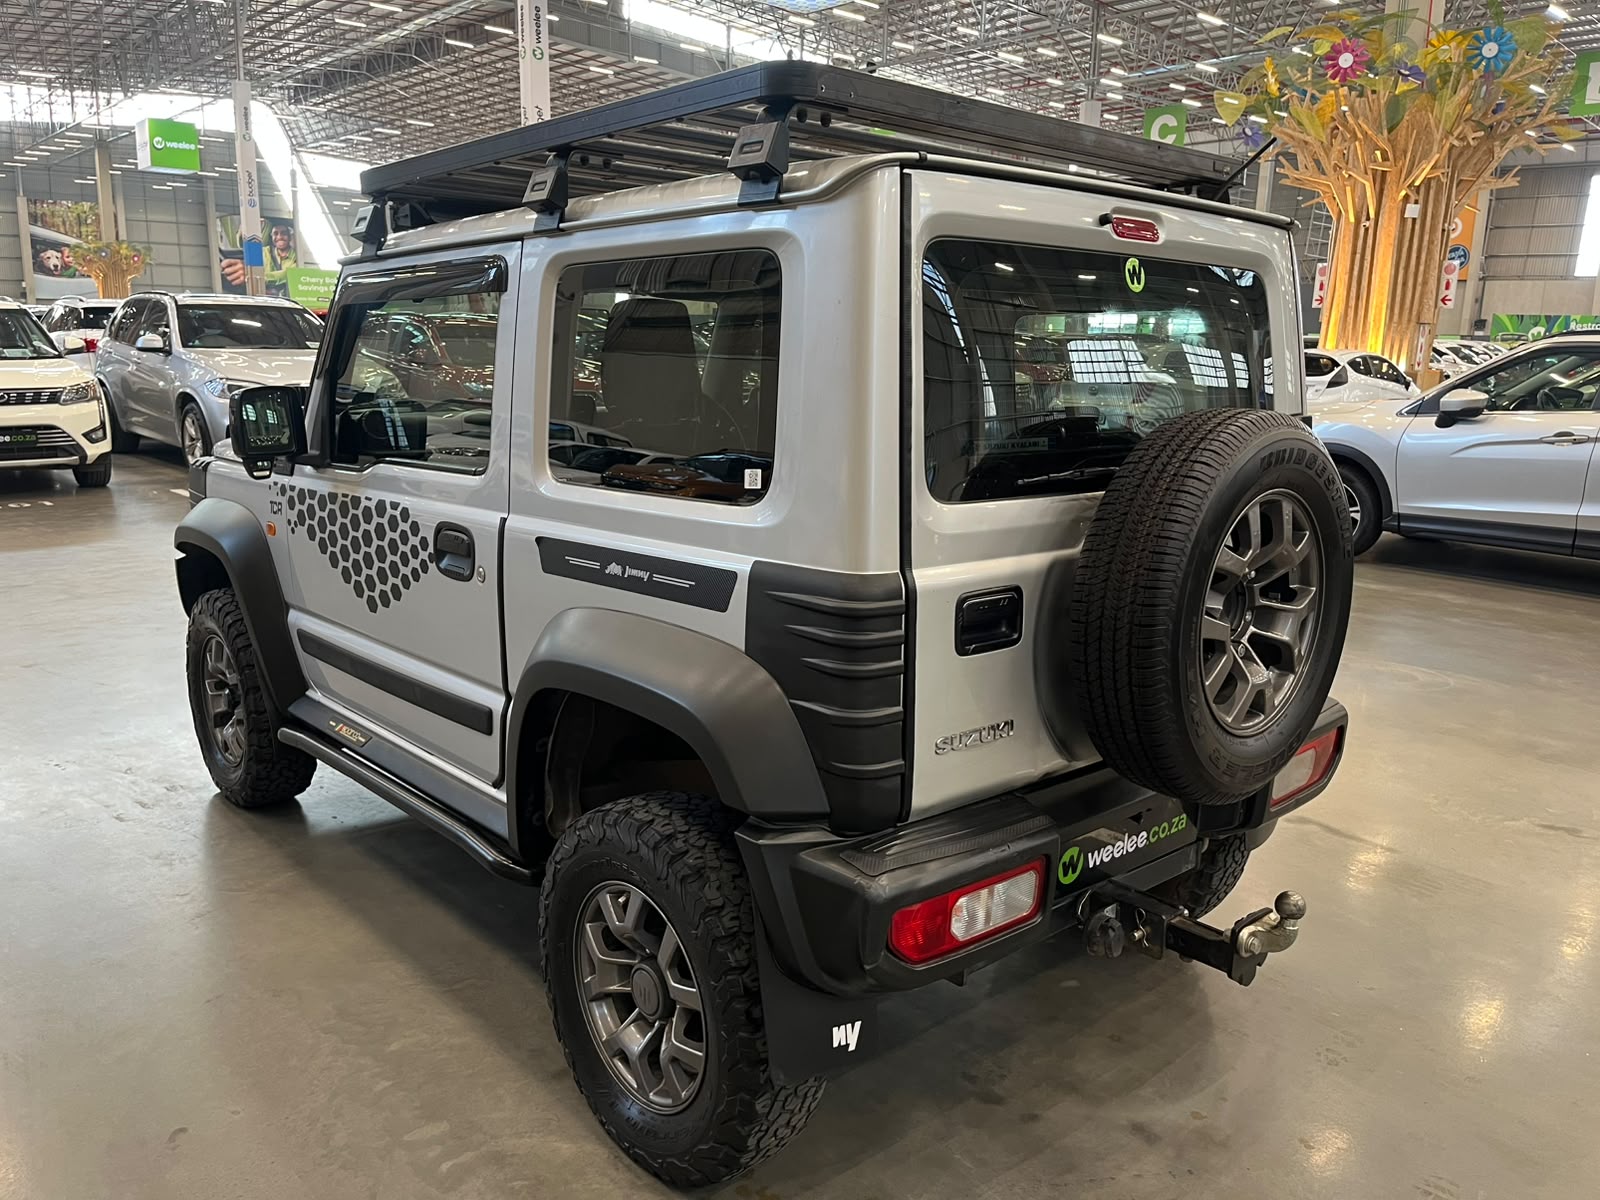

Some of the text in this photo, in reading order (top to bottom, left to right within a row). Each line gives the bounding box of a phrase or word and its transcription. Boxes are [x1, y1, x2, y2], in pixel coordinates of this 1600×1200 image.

[533, 6, 542, 44] weelee
[165, 141, 196, 150] weelee
[1151, 114, 1178, 144] C
[1259, 447, 1353, 560] BRIDGESTONE
[934, 719, 1015, 756] SUZUKI
[1087, 813, 1188, 869] weelee.co.za
